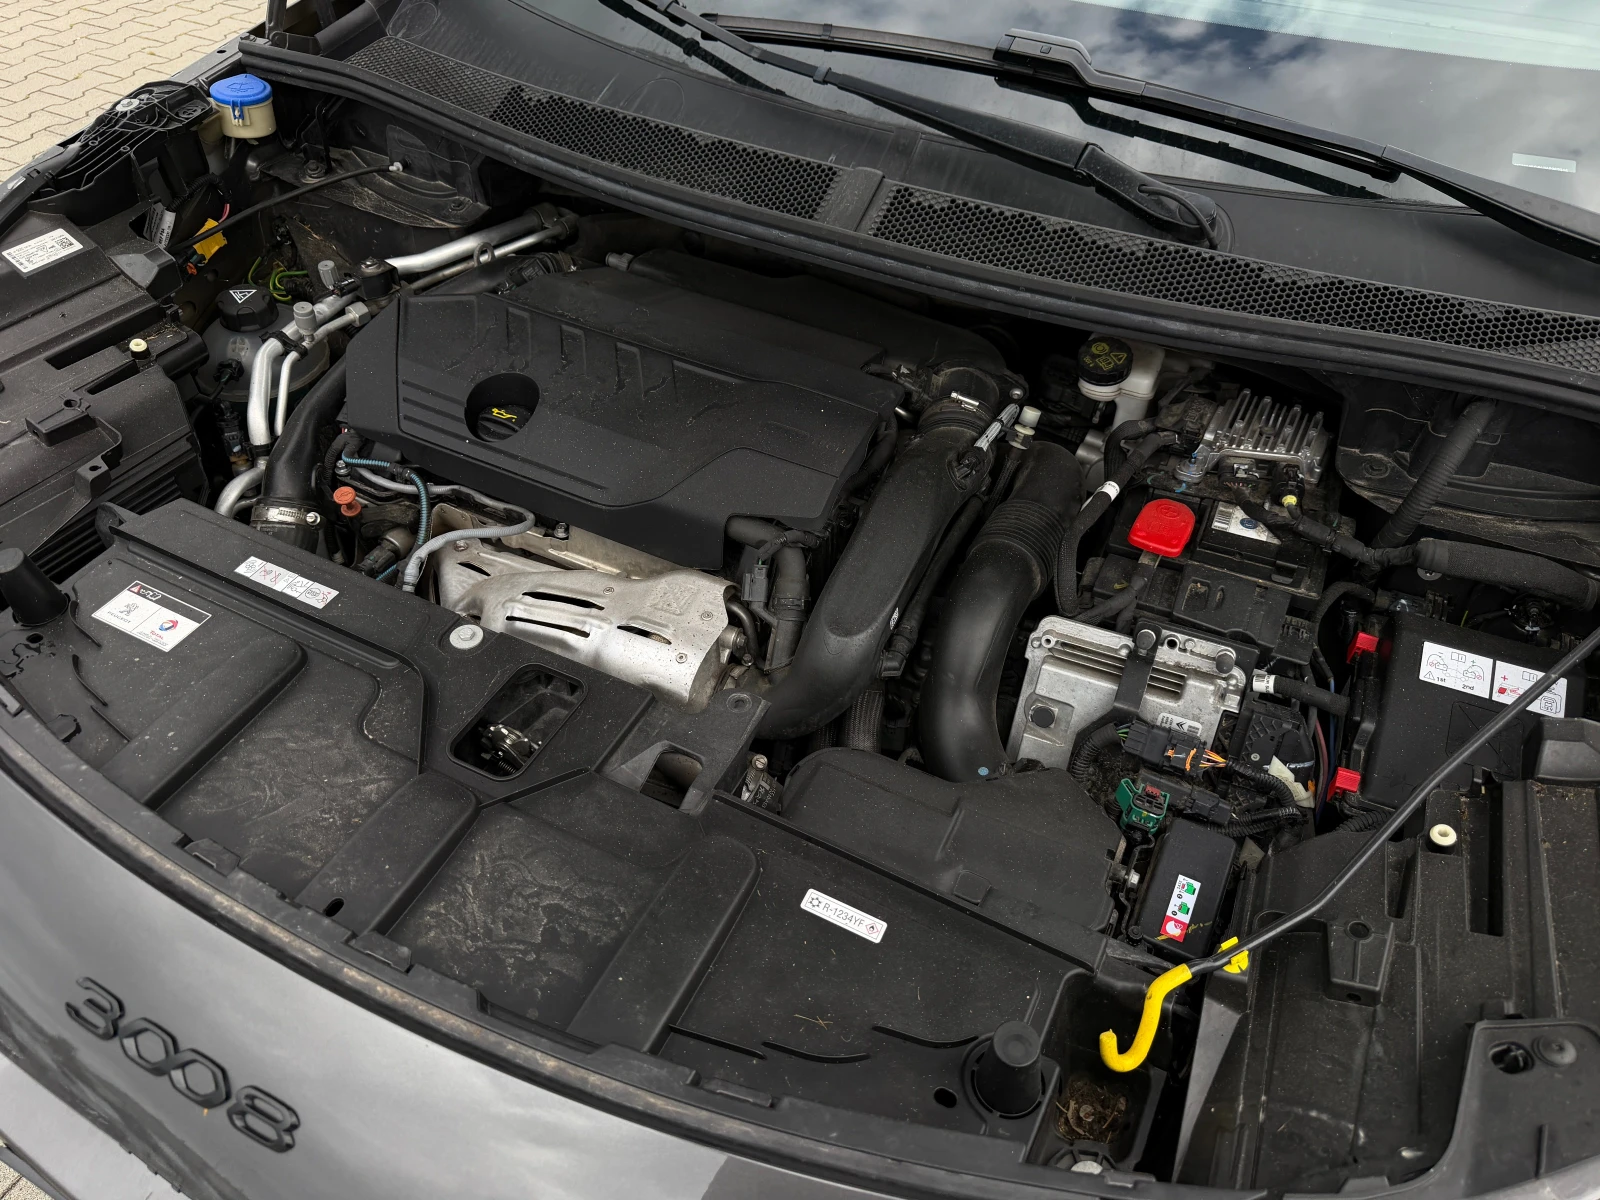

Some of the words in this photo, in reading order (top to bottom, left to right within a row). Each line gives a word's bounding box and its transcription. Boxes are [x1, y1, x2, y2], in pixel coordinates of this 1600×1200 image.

[107, 611, 132, 624] PEUGEOT
[149, 630, 164, 640] TOTAL
[822, 902, 865, 927] R-1234YF
[65, 976, 301, 1153] 3008
